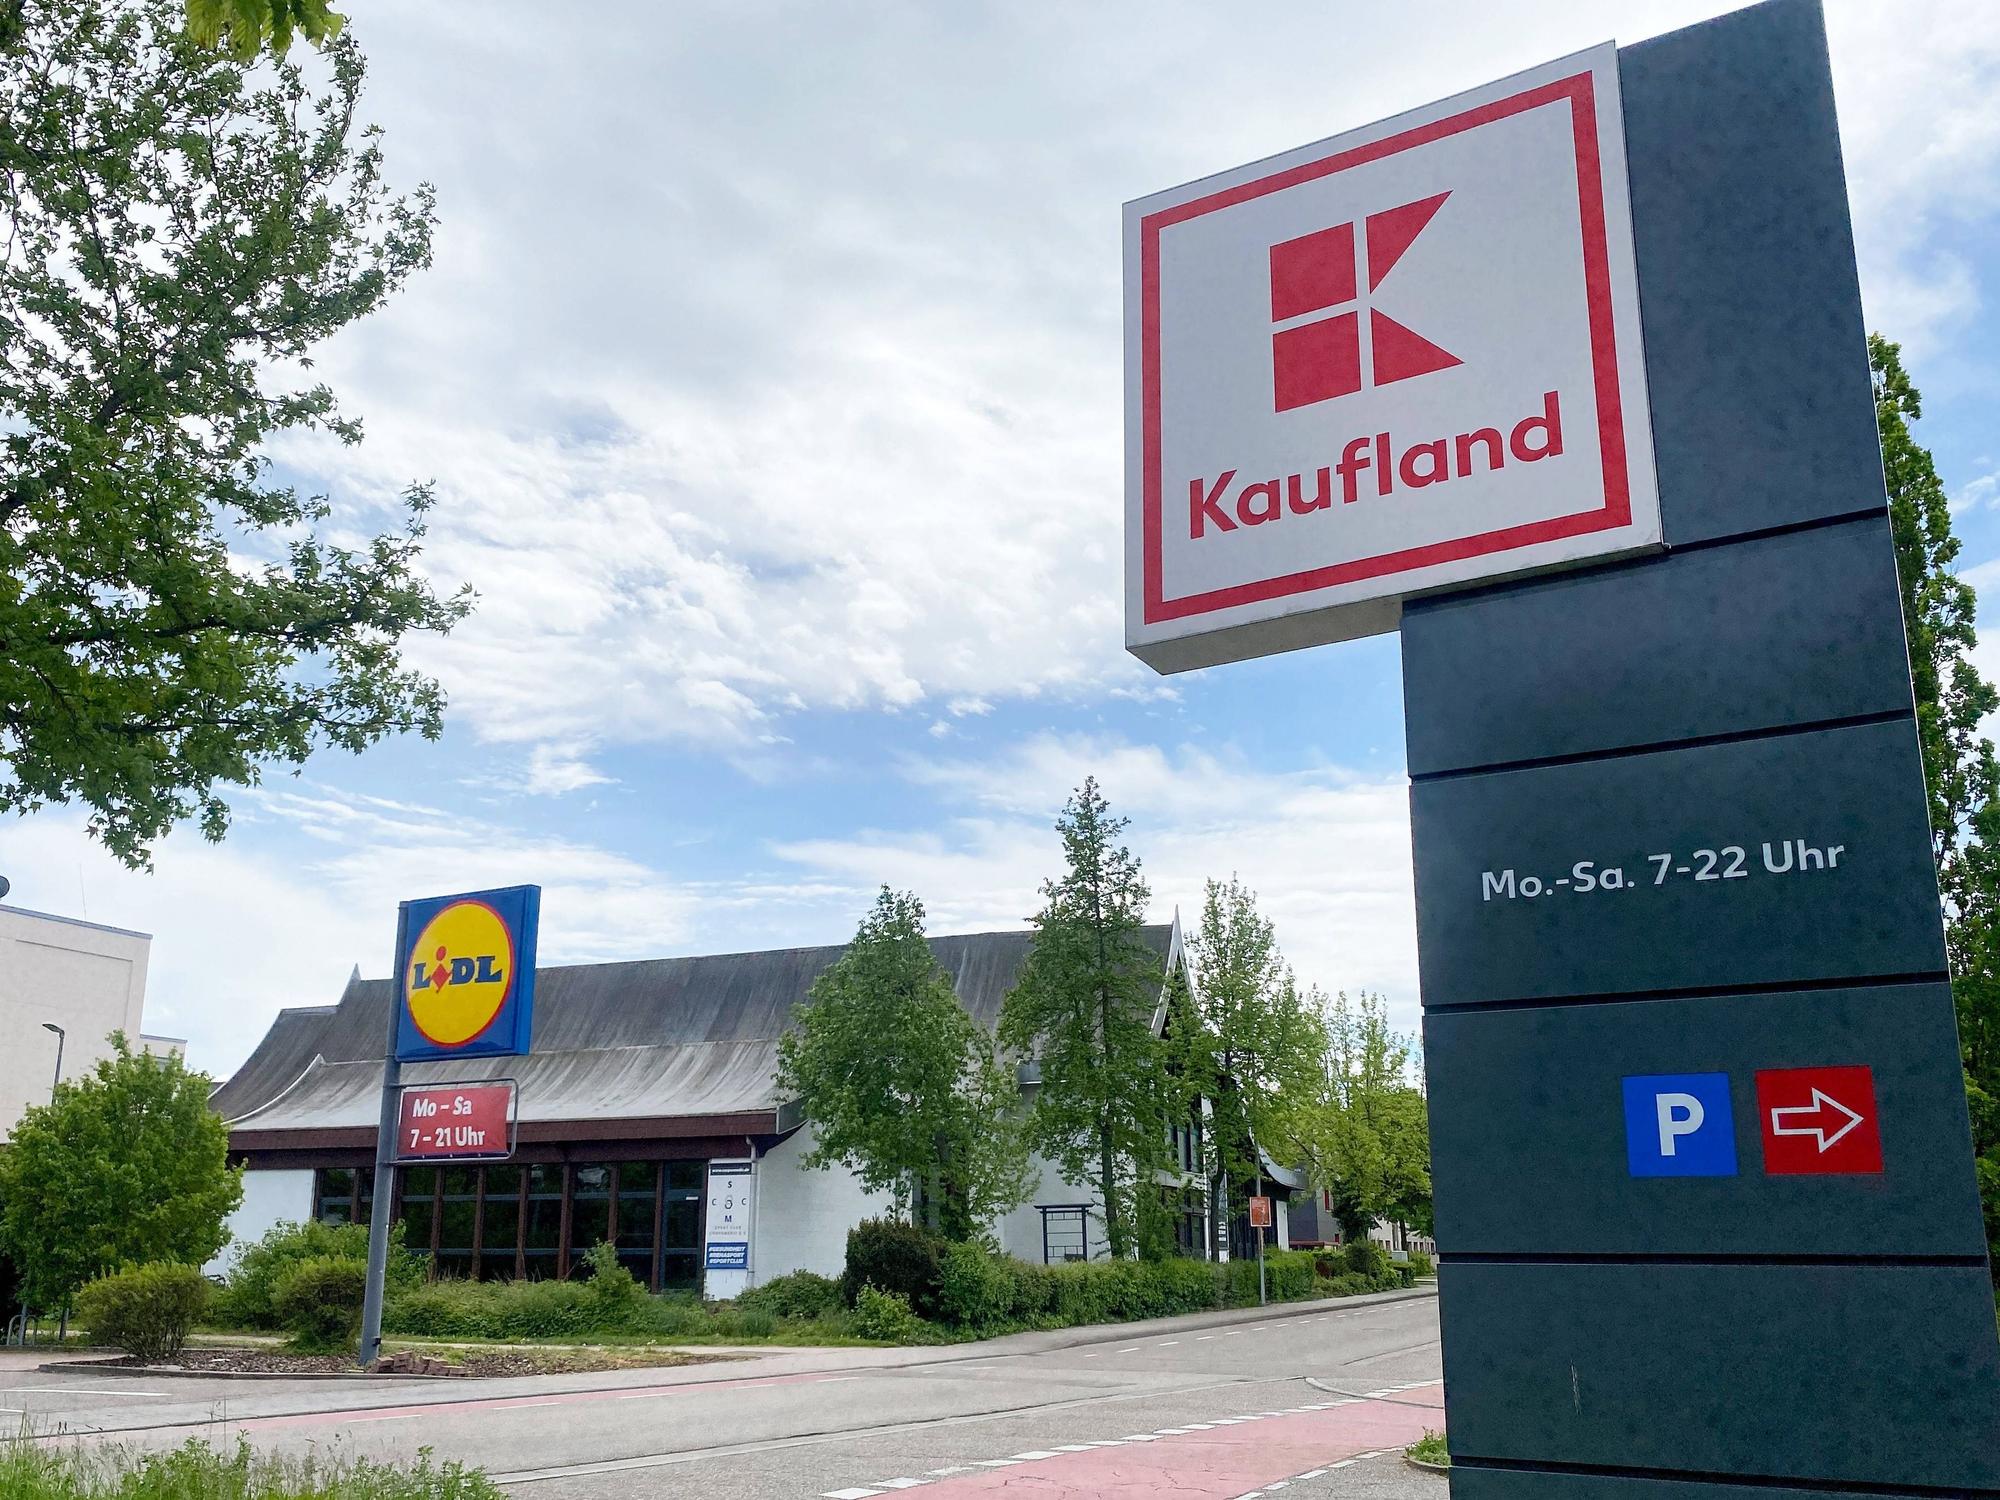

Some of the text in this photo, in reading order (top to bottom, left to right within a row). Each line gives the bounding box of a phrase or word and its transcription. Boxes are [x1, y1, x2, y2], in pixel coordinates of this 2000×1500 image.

[1190, 391, 1564, 539] Kaufland
[1482, 839, 1845, 901] Mo.-Sa. 7-22 Uhr
[412, 1098, 436, 1118] Mo
[452, 1096, 472, 1115] Sa
[1655, 1092, 1705, 1156] P
[410, 1129, 419, 1148] 7
[435, 1127, 451, 1147] 21
[455, 1125, 486, 1146] Uhr
[727, 1181, 733, 1189] S
[724, 1215, 732, 1223] M
